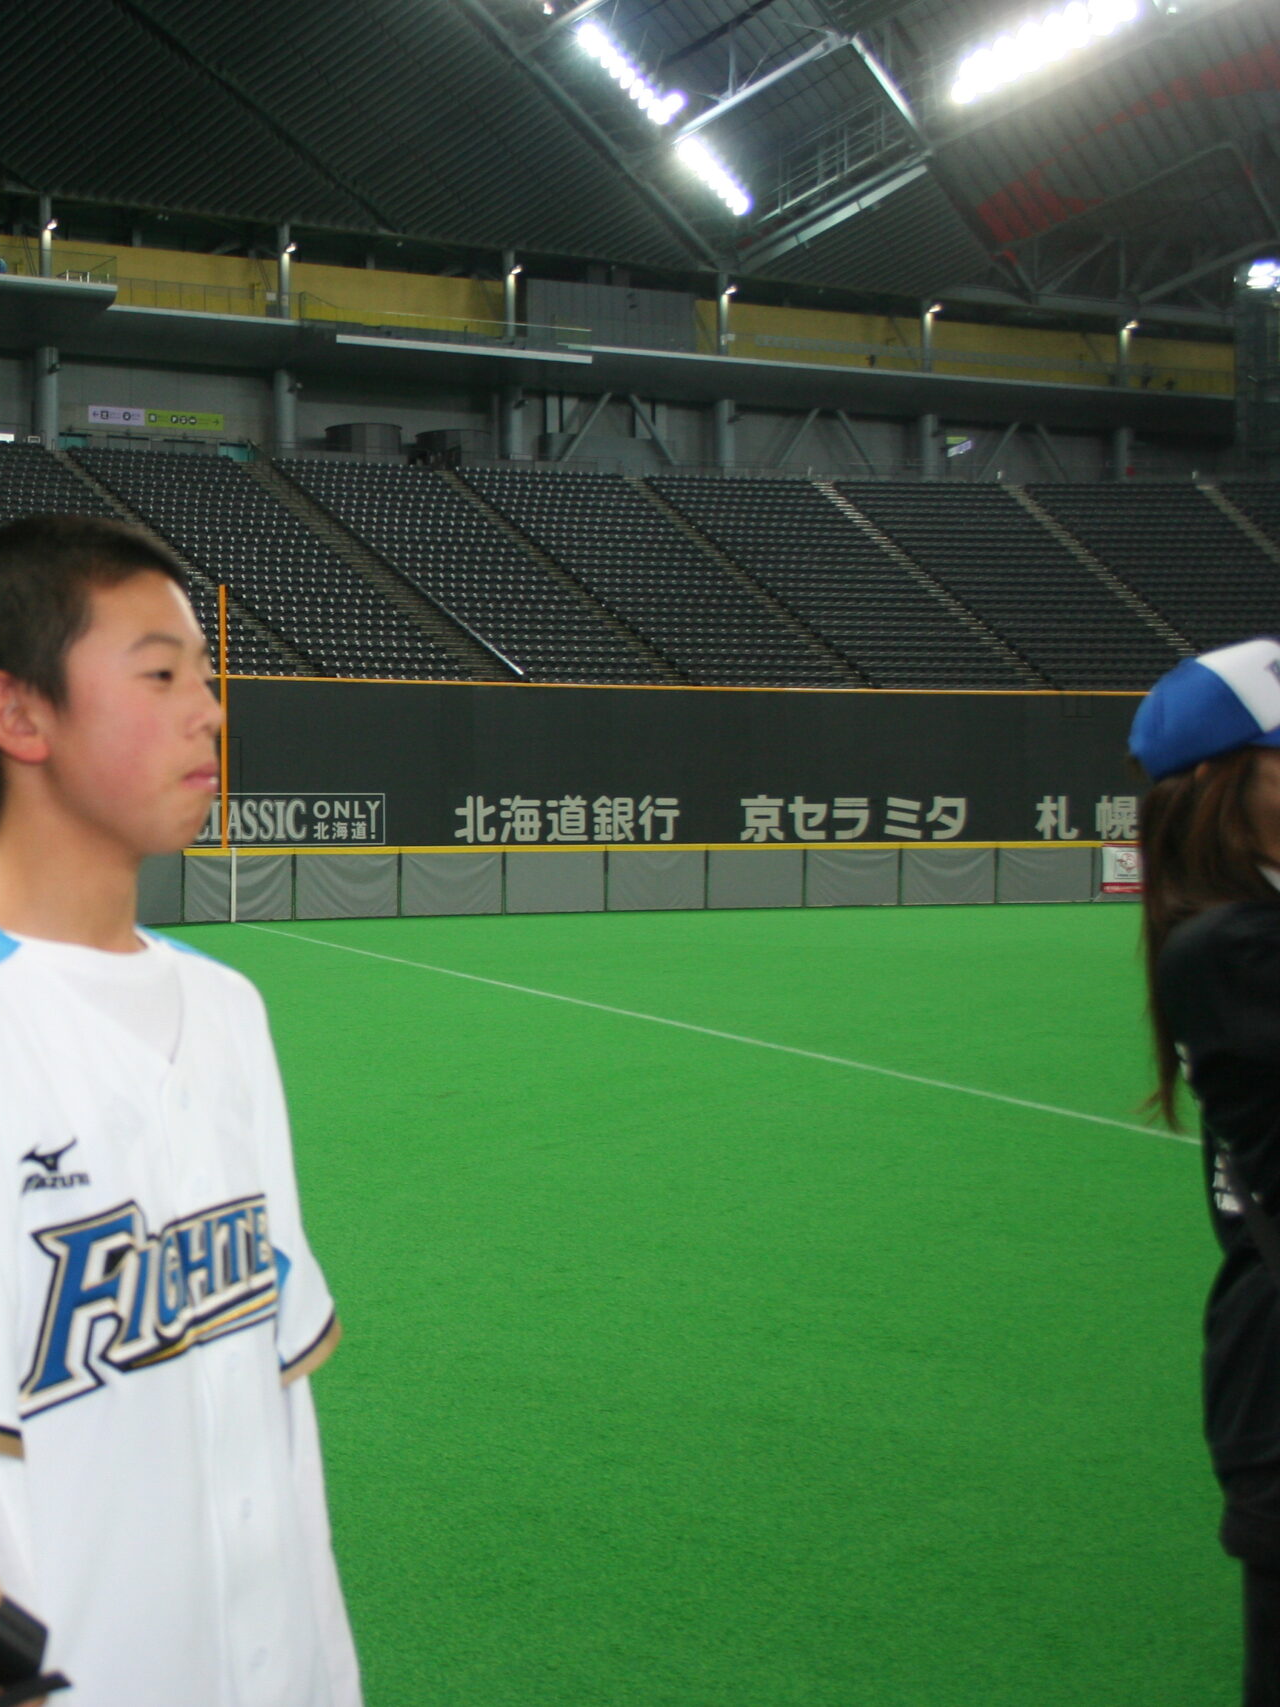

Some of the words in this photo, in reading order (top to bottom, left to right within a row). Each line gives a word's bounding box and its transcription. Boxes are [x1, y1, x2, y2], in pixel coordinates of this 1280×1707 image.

[312, 800, 381, 826] ONLY
[454, 794, 681, 844] 北海道銀行
[740, 794, 967, 843] 京セラミタ
[1034, 794, 1139, 841] 札幌
